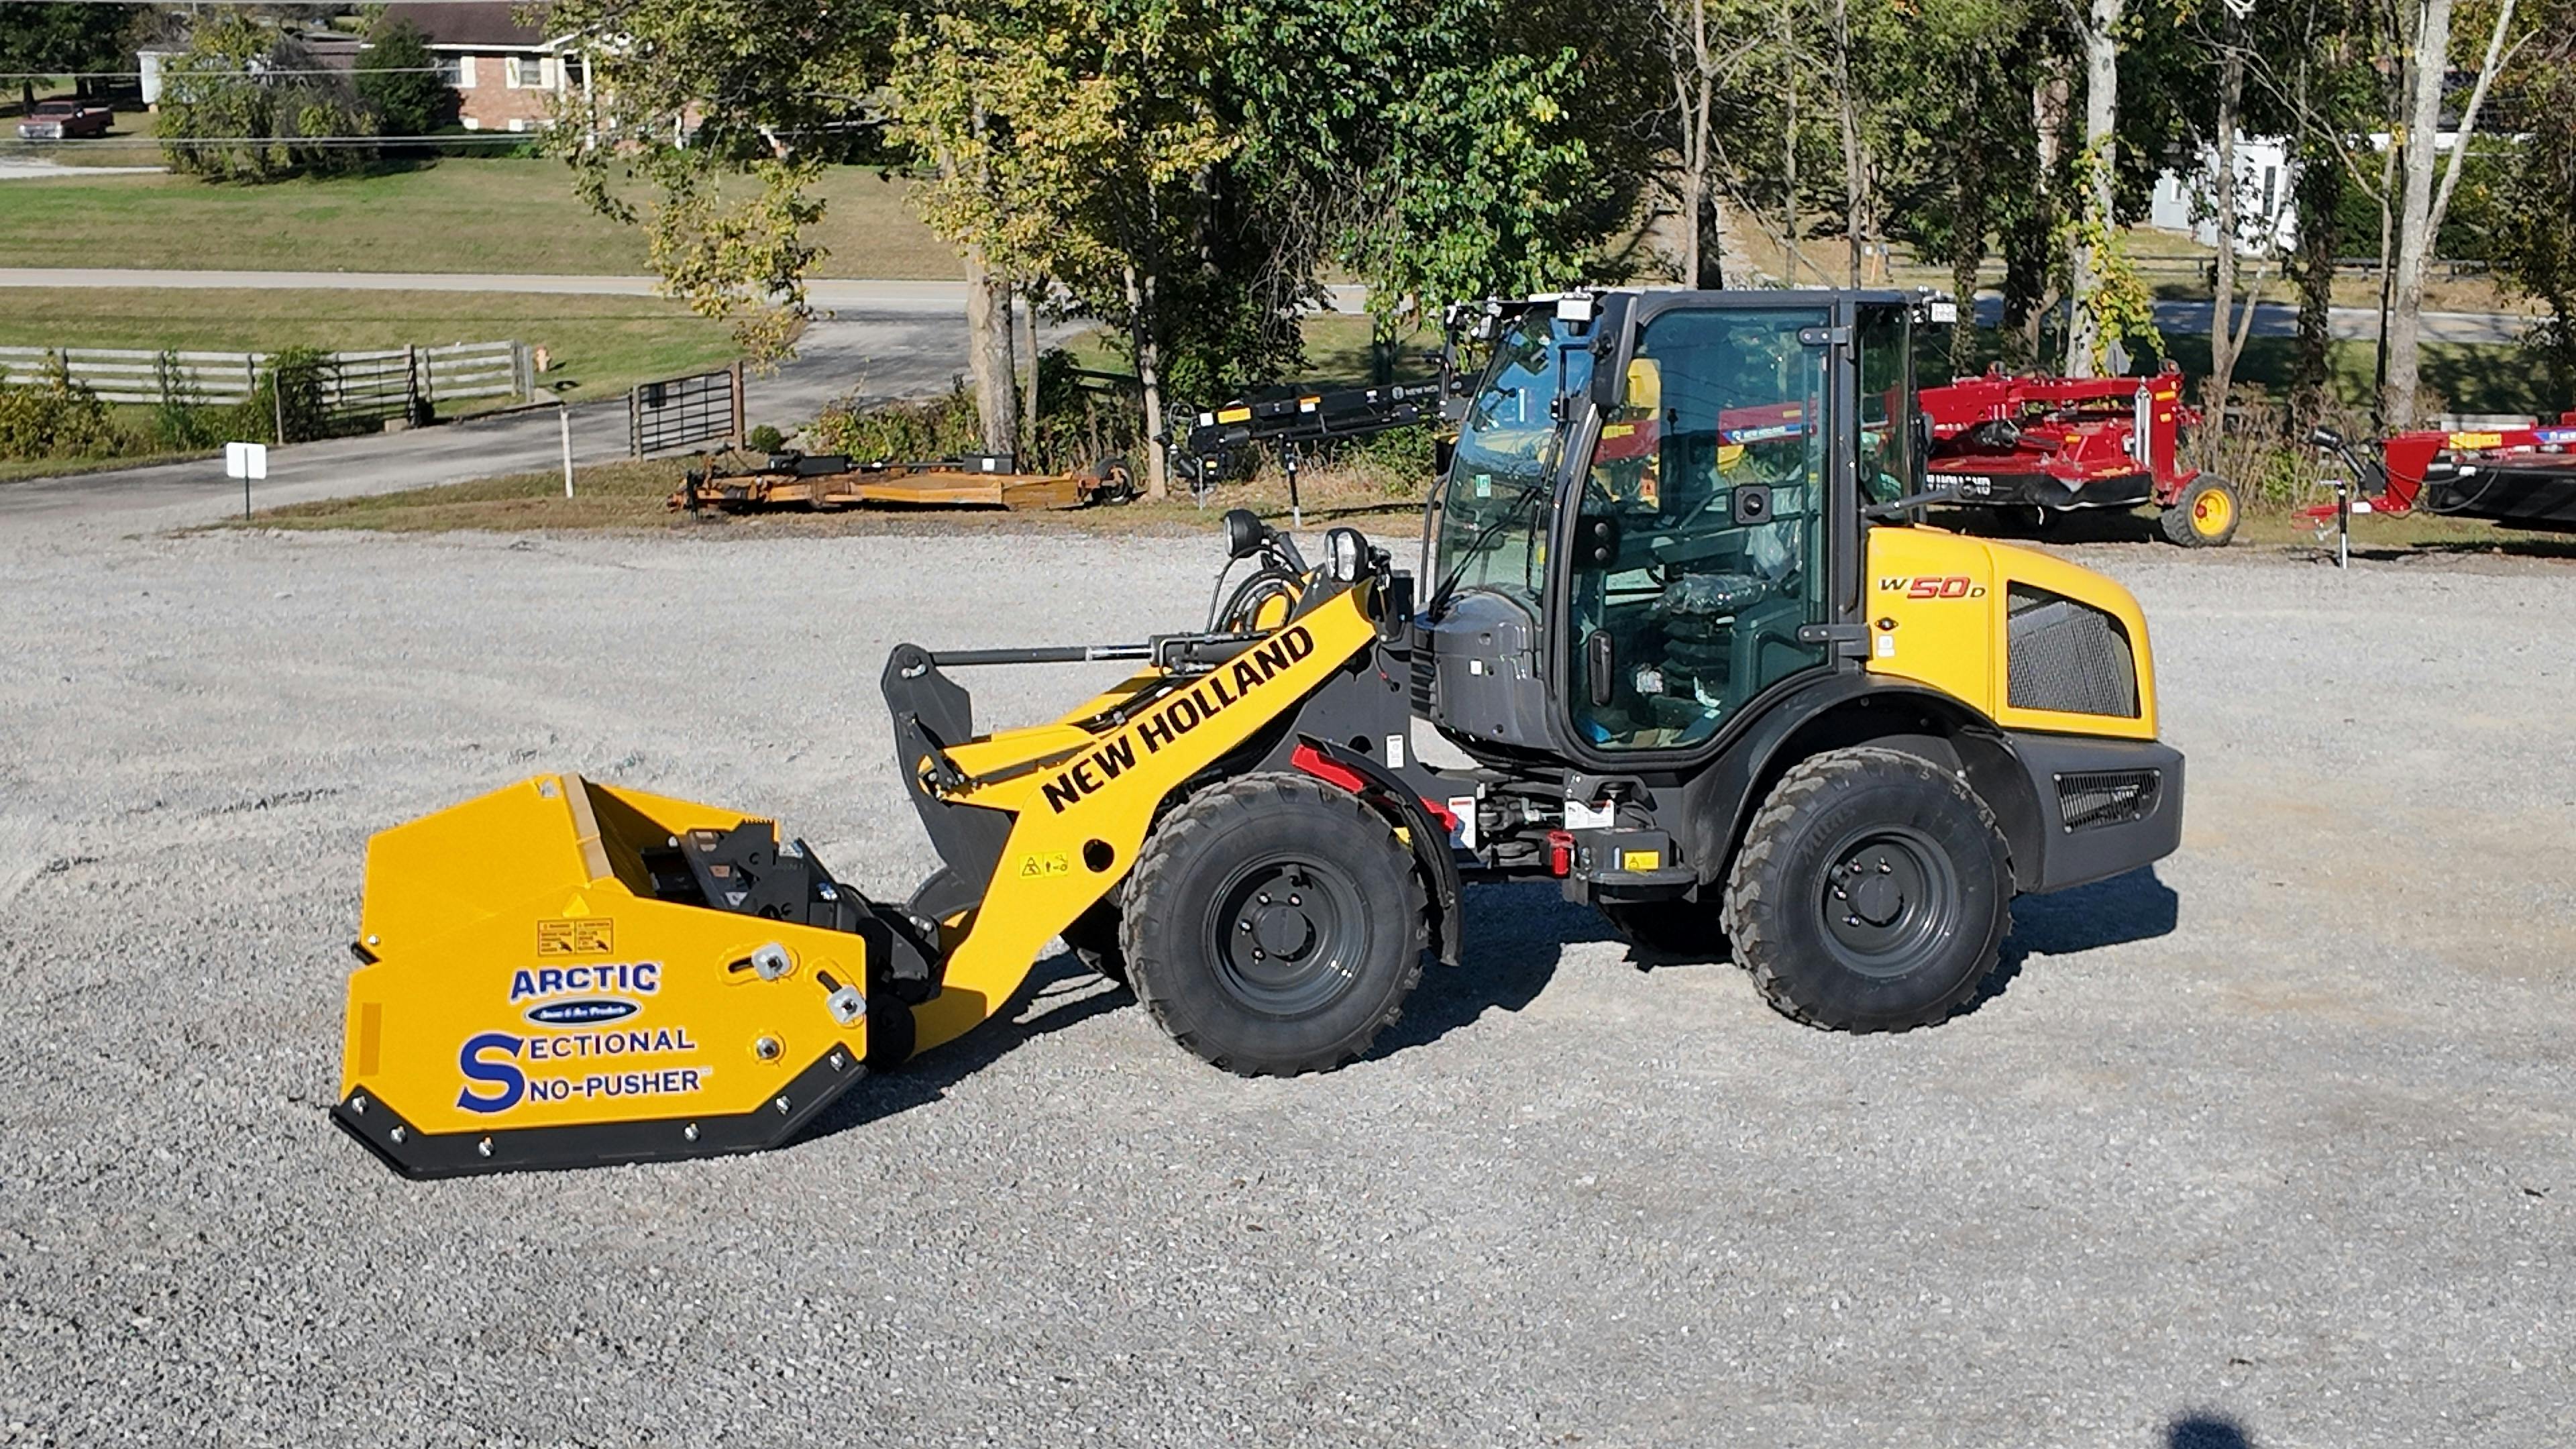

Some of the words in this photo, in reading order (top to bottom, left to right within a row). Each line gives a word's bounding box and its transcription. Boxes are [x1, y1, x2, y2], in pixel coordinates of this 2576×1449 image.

[1041, 735, 1136, 814] NEW
[1137, 626, 1314, 754] HOLLAND
[511, 963, 657, 1000] ARCTIC
